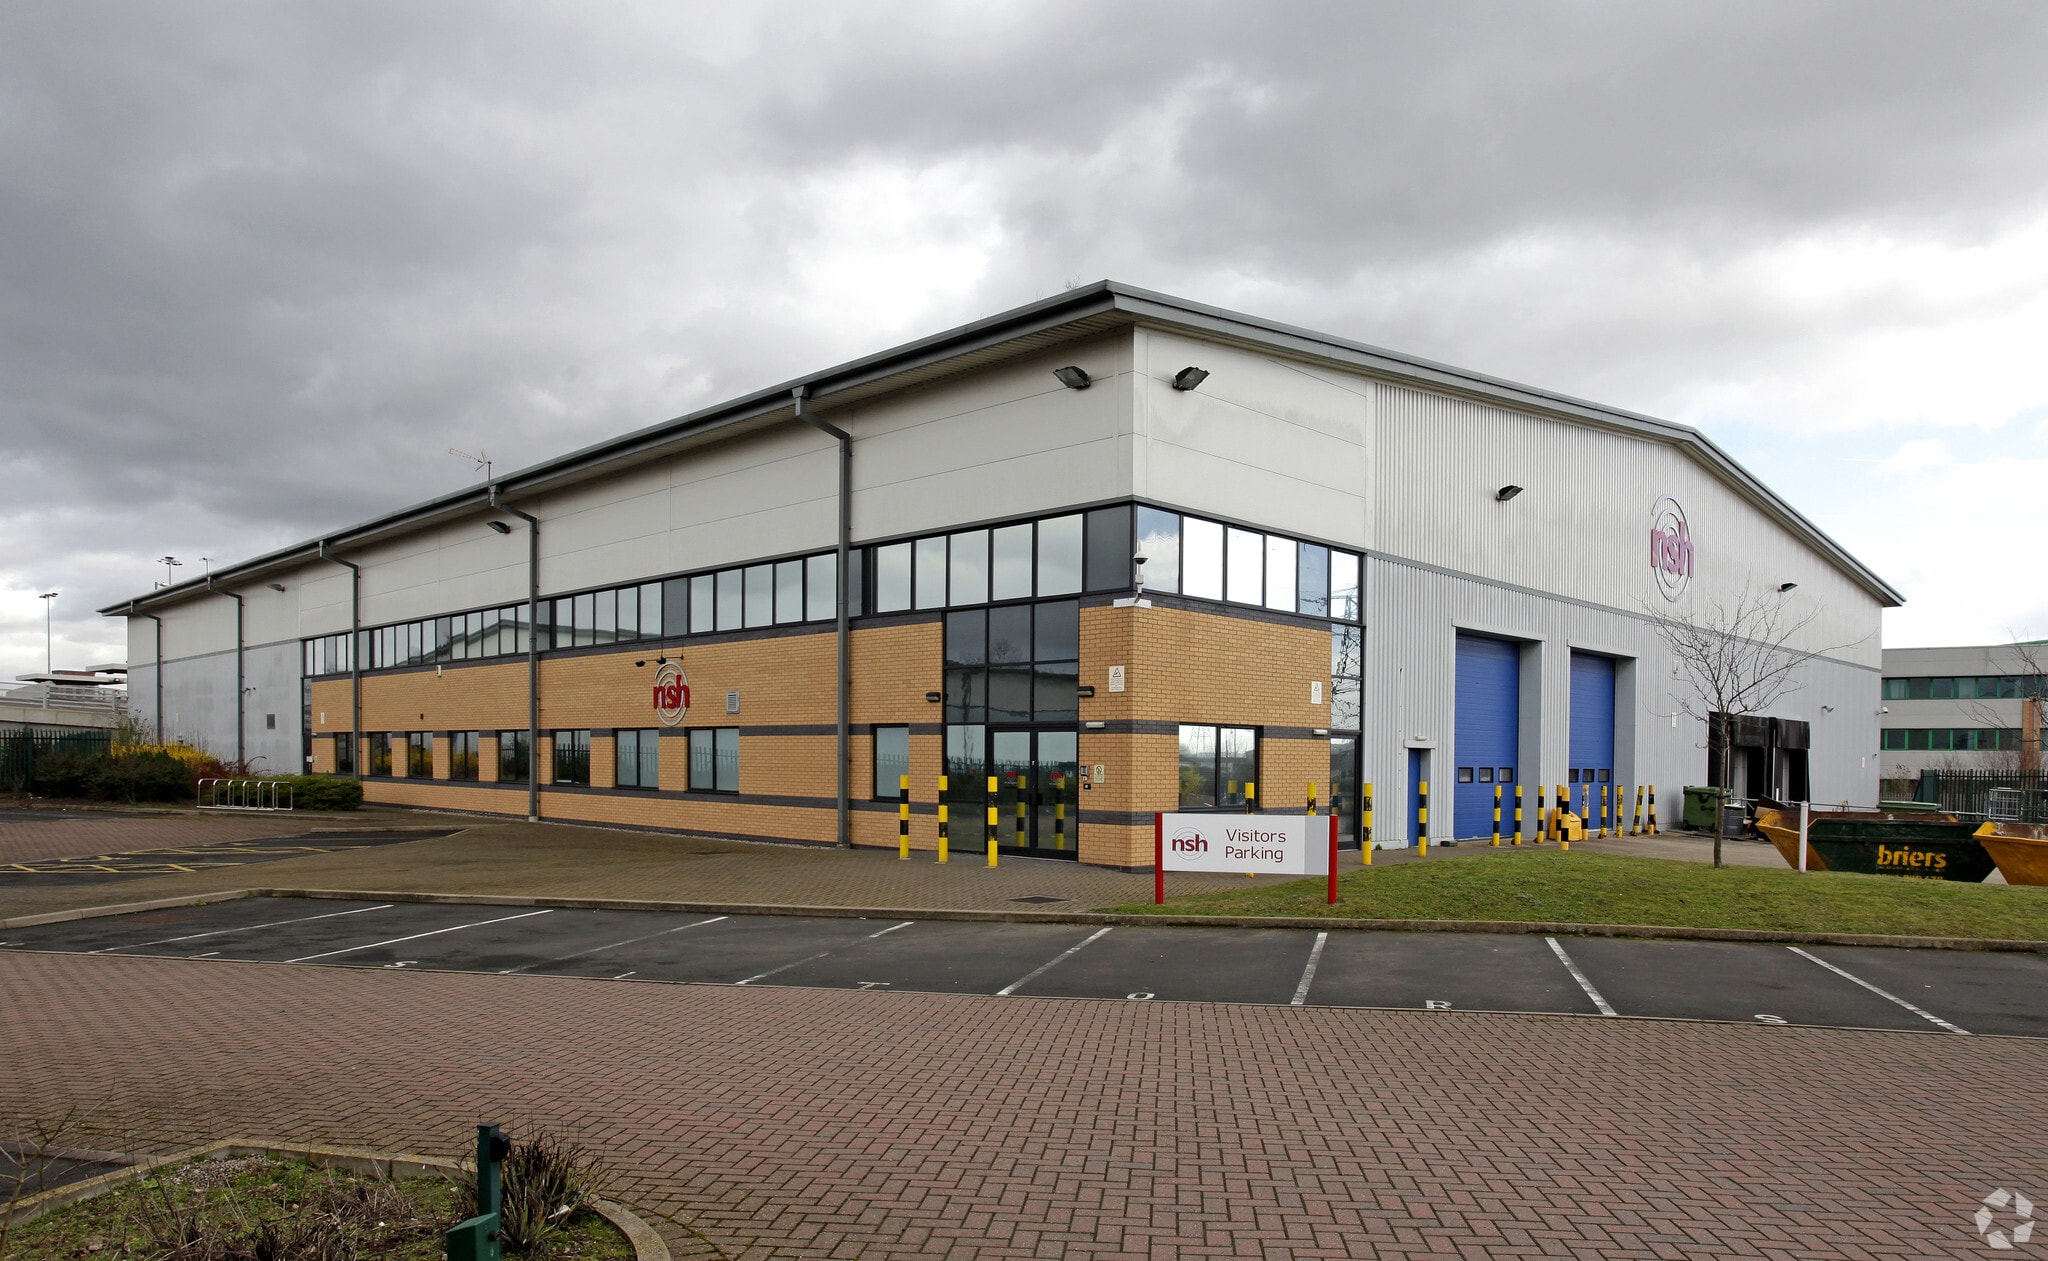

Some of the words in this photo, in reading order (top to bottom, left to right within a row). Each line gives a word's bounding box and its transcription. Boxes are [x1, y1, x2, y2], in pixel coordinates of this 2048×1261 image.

[1650, 520, 1694, 578] nsh
[653, 674, 690, 709] nsh
[1171, 834, 1208, 852] nsh
[1226, 828, 1286, 843] Visitors
[1225, 846, 1284, 863] Parking
[1877, 844, 1947, 868] briers
